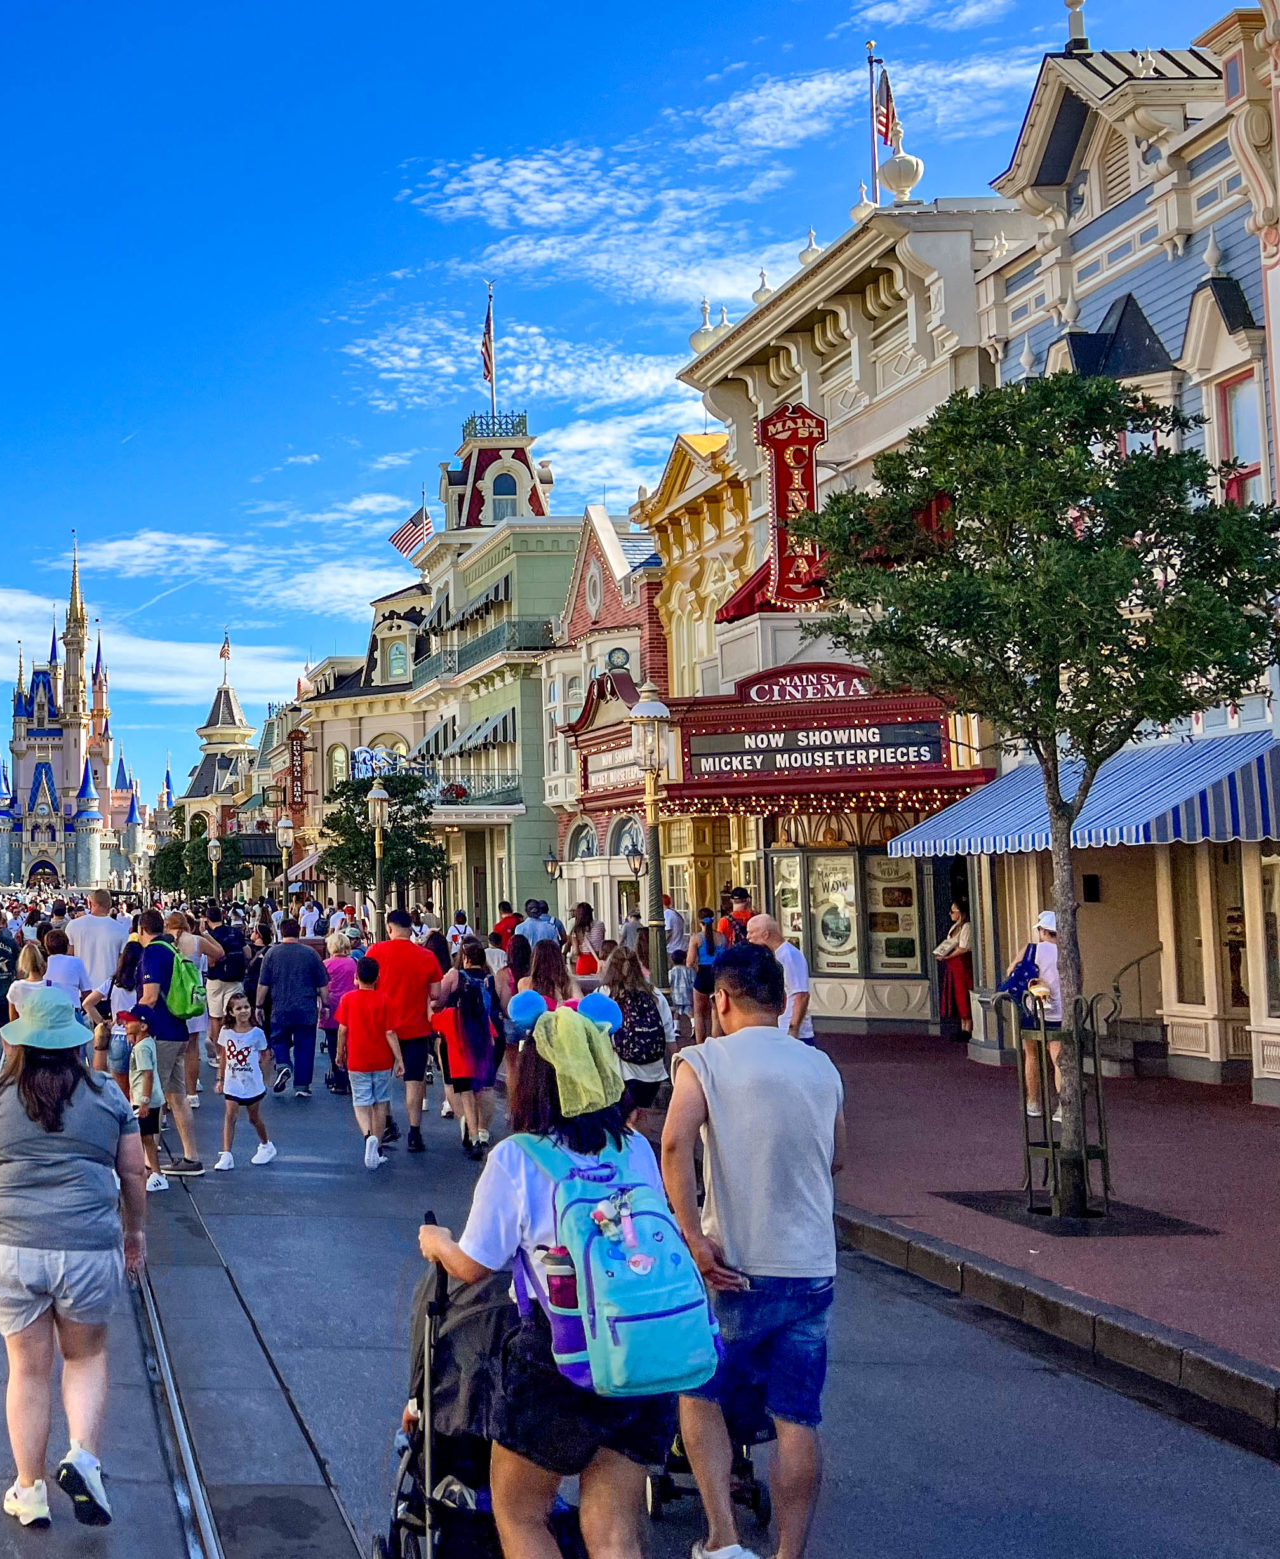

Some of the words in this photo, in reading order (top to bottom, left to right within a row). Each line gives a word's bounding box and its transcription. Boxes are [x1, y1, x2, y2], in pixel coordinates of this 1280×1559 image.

[767, 418, 817, 437] MAIN
[783, 444, 815, 579] CINMA
[749, 678, 869, 702] CINEMA
[779, 674, 819, 686] MAIN
[820, 674, 839, 684] ST
[744, 733, 785, 749] NOW
[797, 728, 881, 747] SHOWING
[292, 740, 302, 777] CRYSTAL
[700, 755, 765, 772] MICKEY
[775, 747, 931, 768] MOUSETERPIECES
[292, 780, 302, 803] ARTS
